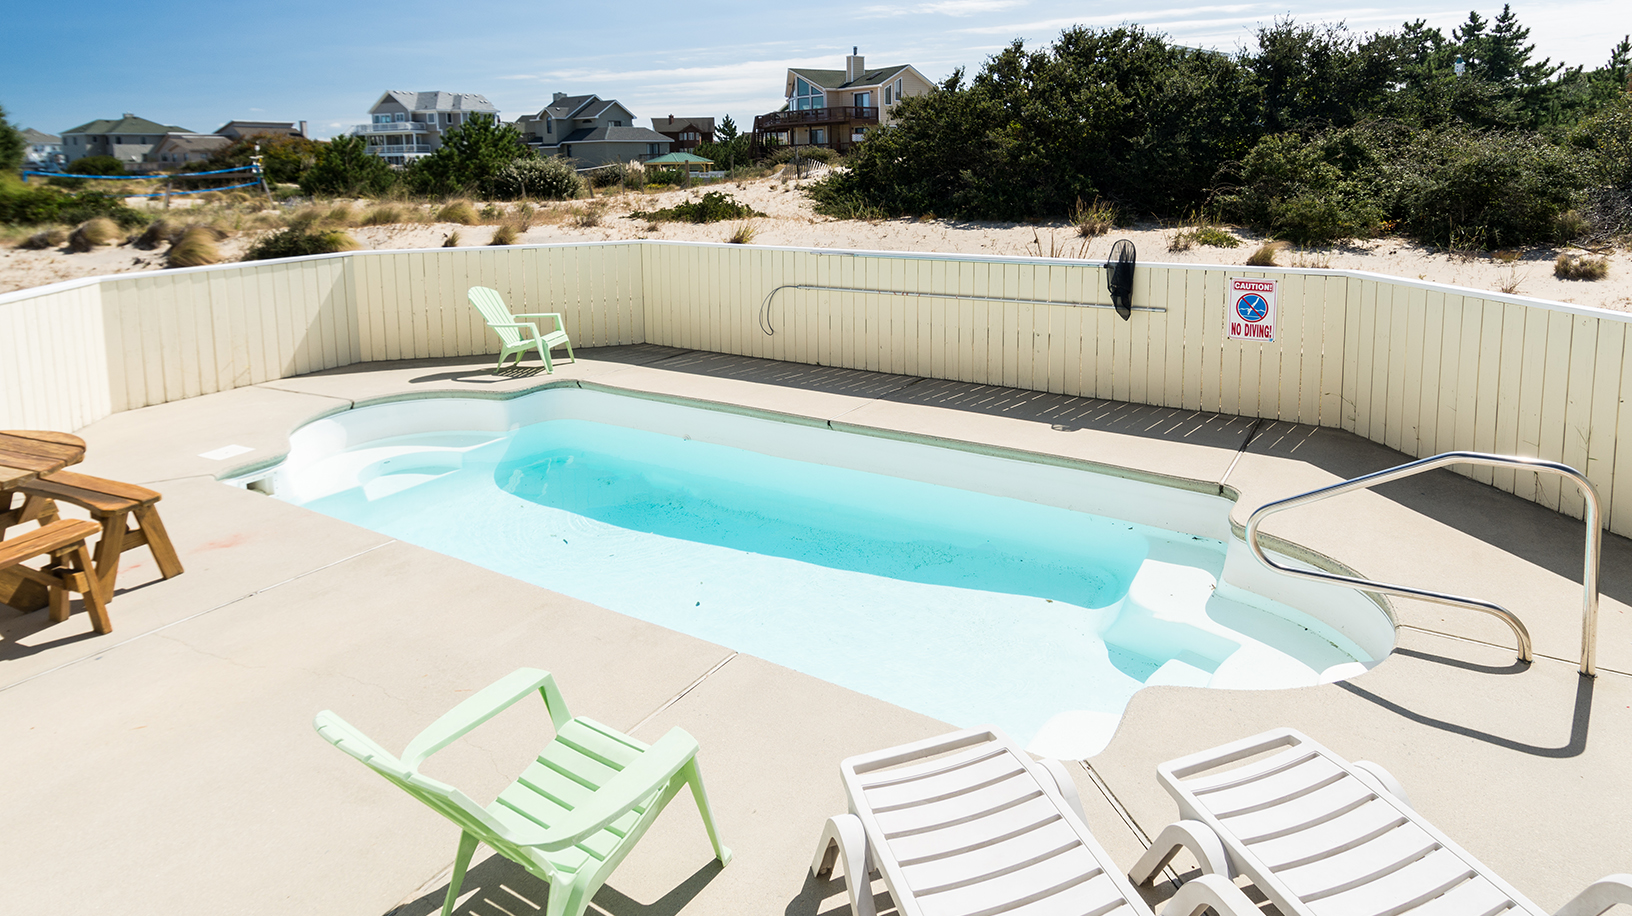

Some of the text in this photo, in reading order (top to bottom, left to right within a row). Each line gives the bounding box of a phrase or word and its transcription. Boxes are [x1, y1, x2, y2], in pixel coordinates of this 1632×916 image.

[1234, 282, 1273, 291] CAUTION!
[1231, 322, 1272, 338] NO DIVING!
